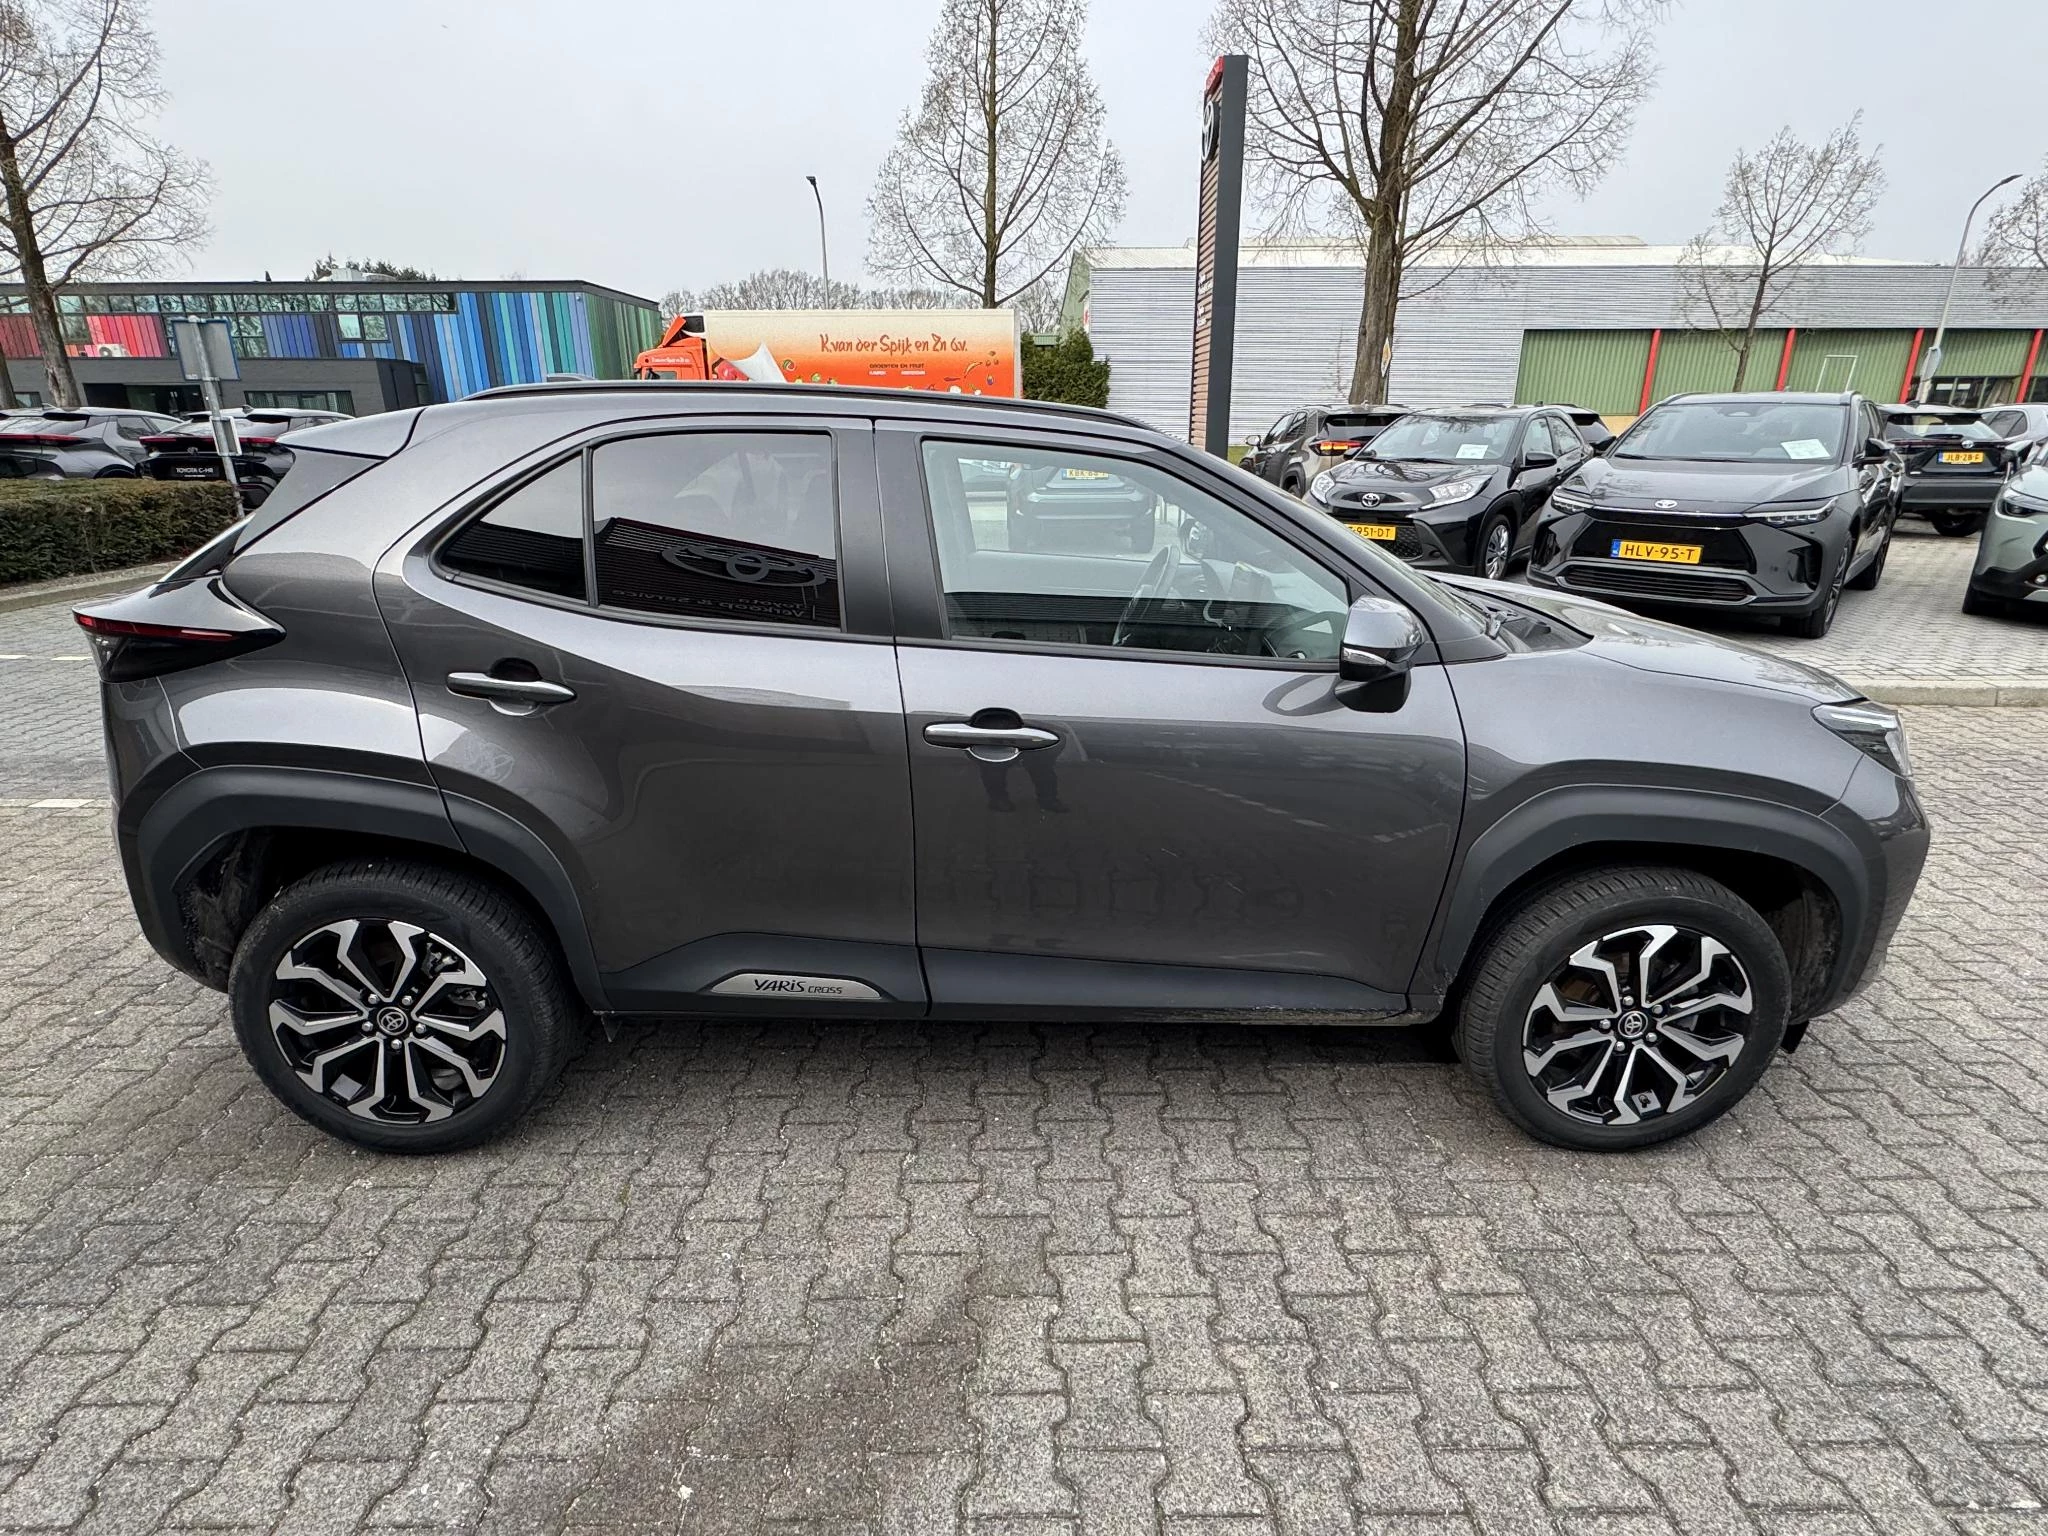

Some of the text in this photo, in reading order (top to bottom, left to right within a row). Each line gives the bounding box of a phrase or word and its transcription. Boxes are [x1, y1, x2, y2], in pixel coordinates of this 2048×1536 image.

[855, 336, 878, 352] der
[879, 334, 912, 356] Spijk
[914, 340, 929, 352] en
[1348, 526, 1391, 538] -951-DT
[1624, 543, 1695, 561] HLV-95-T
[807, 985, 844, 995] CROSS
